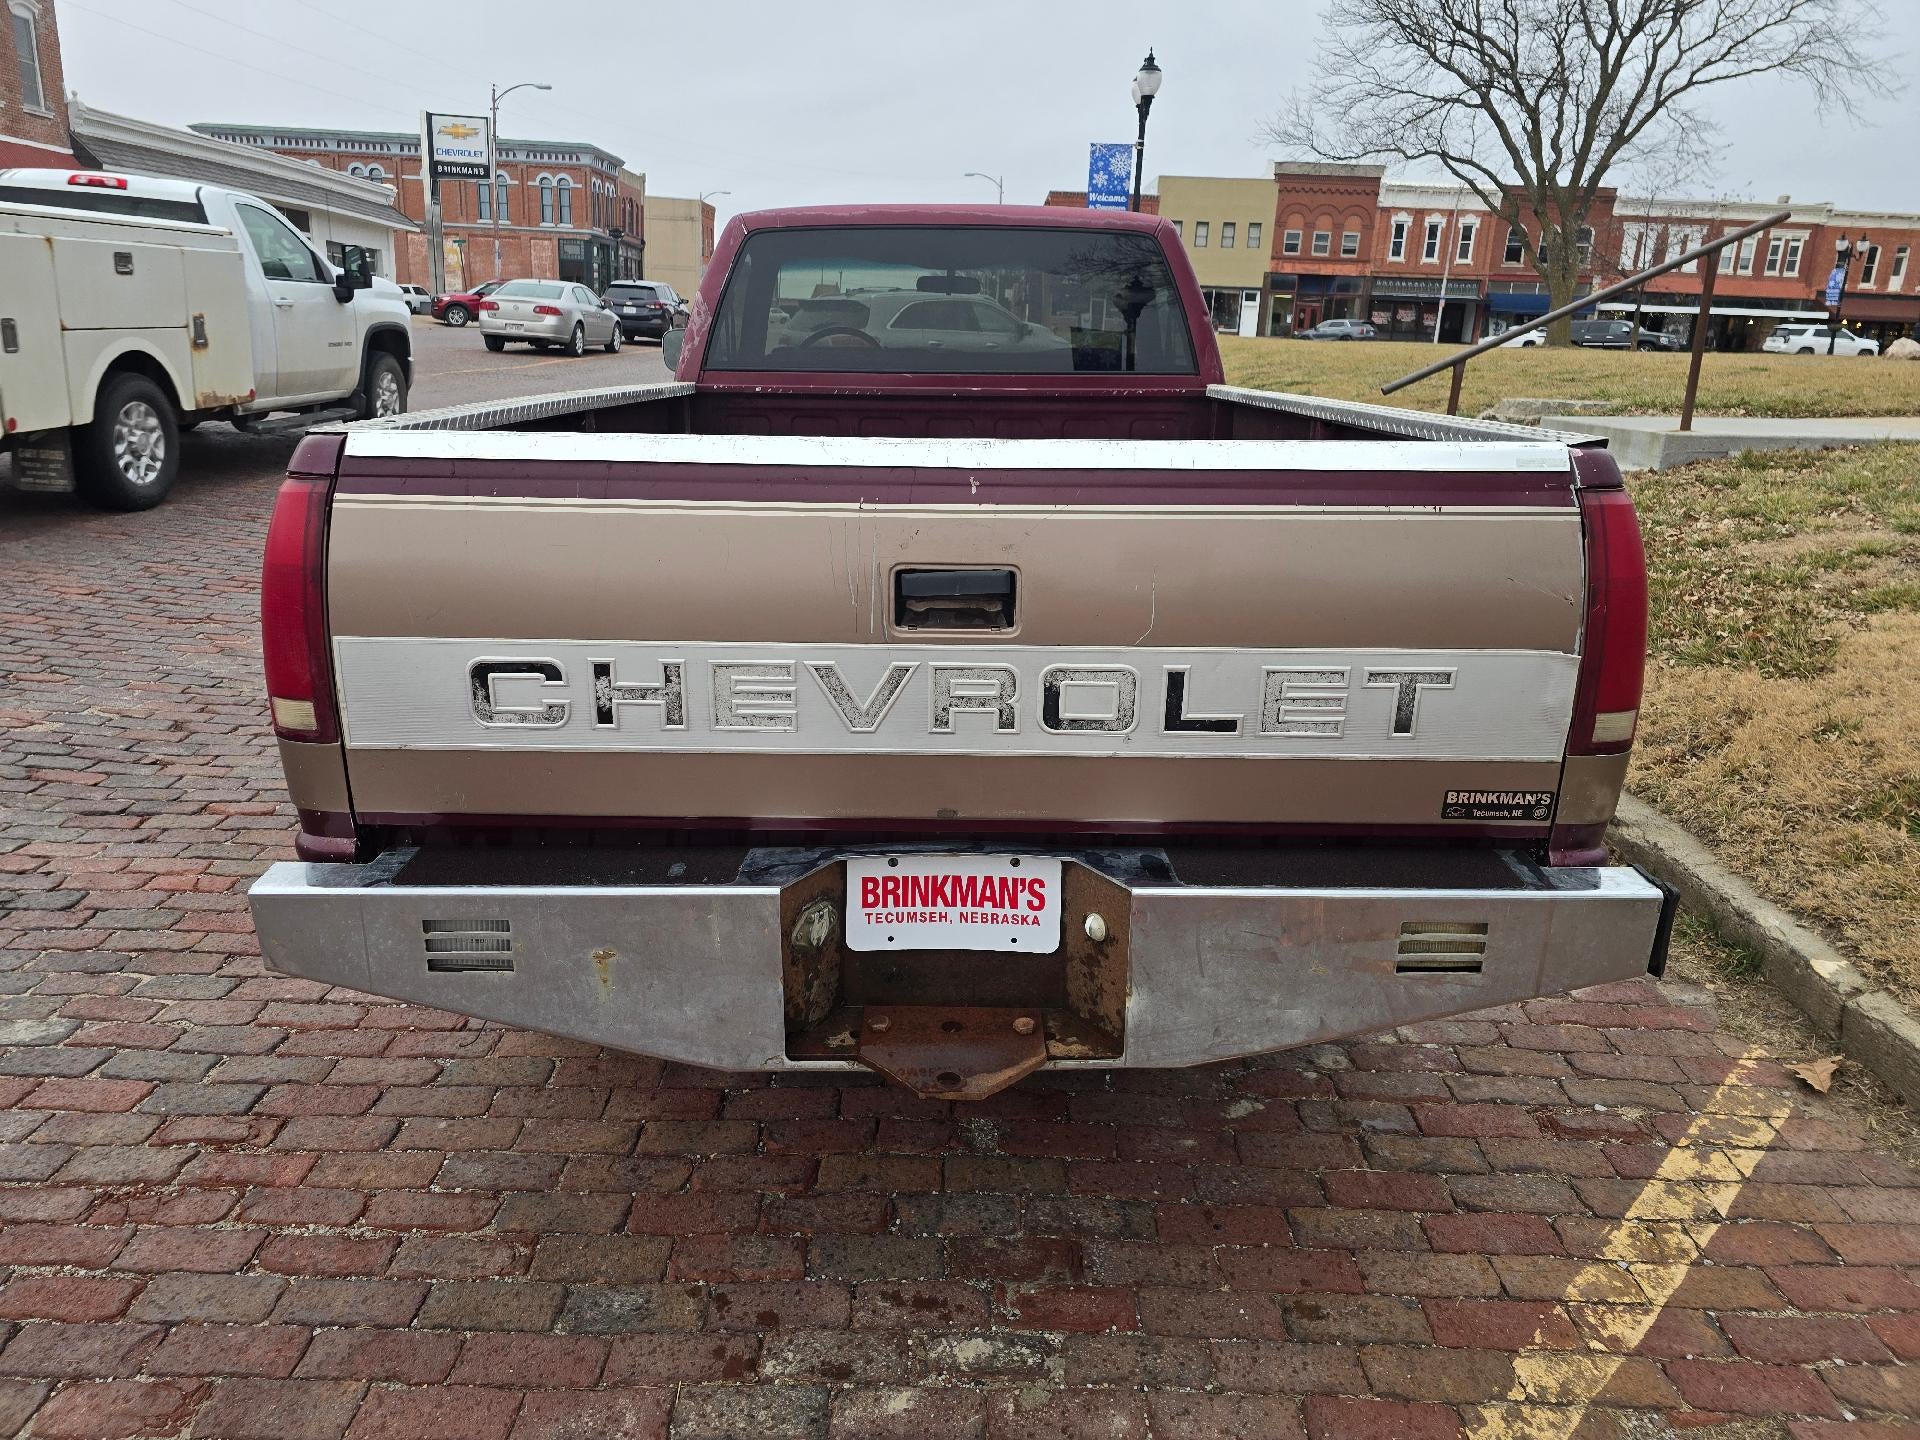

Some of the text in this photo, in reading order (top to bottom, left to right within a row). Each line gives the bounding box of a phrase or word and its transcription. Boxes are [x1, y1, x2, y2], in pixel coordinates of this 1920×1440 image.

[436, 147, 484, 158] CHEVROLET
[437, 165, 485, 176] BRINKMAN'S
[1089, 192, 1128, 203] Welcome
[466, 656, 1458, 740] CHEVROLET
[1446, 791, 1552, 805] BRINKMAN'S
[1472, 808, 1524, 819] Tecumseh, NE
[861, 875, 1046, 912] BRINKMAN'S
[864, 912, 1041, 927] TECUMSEH, NEBRASKA
